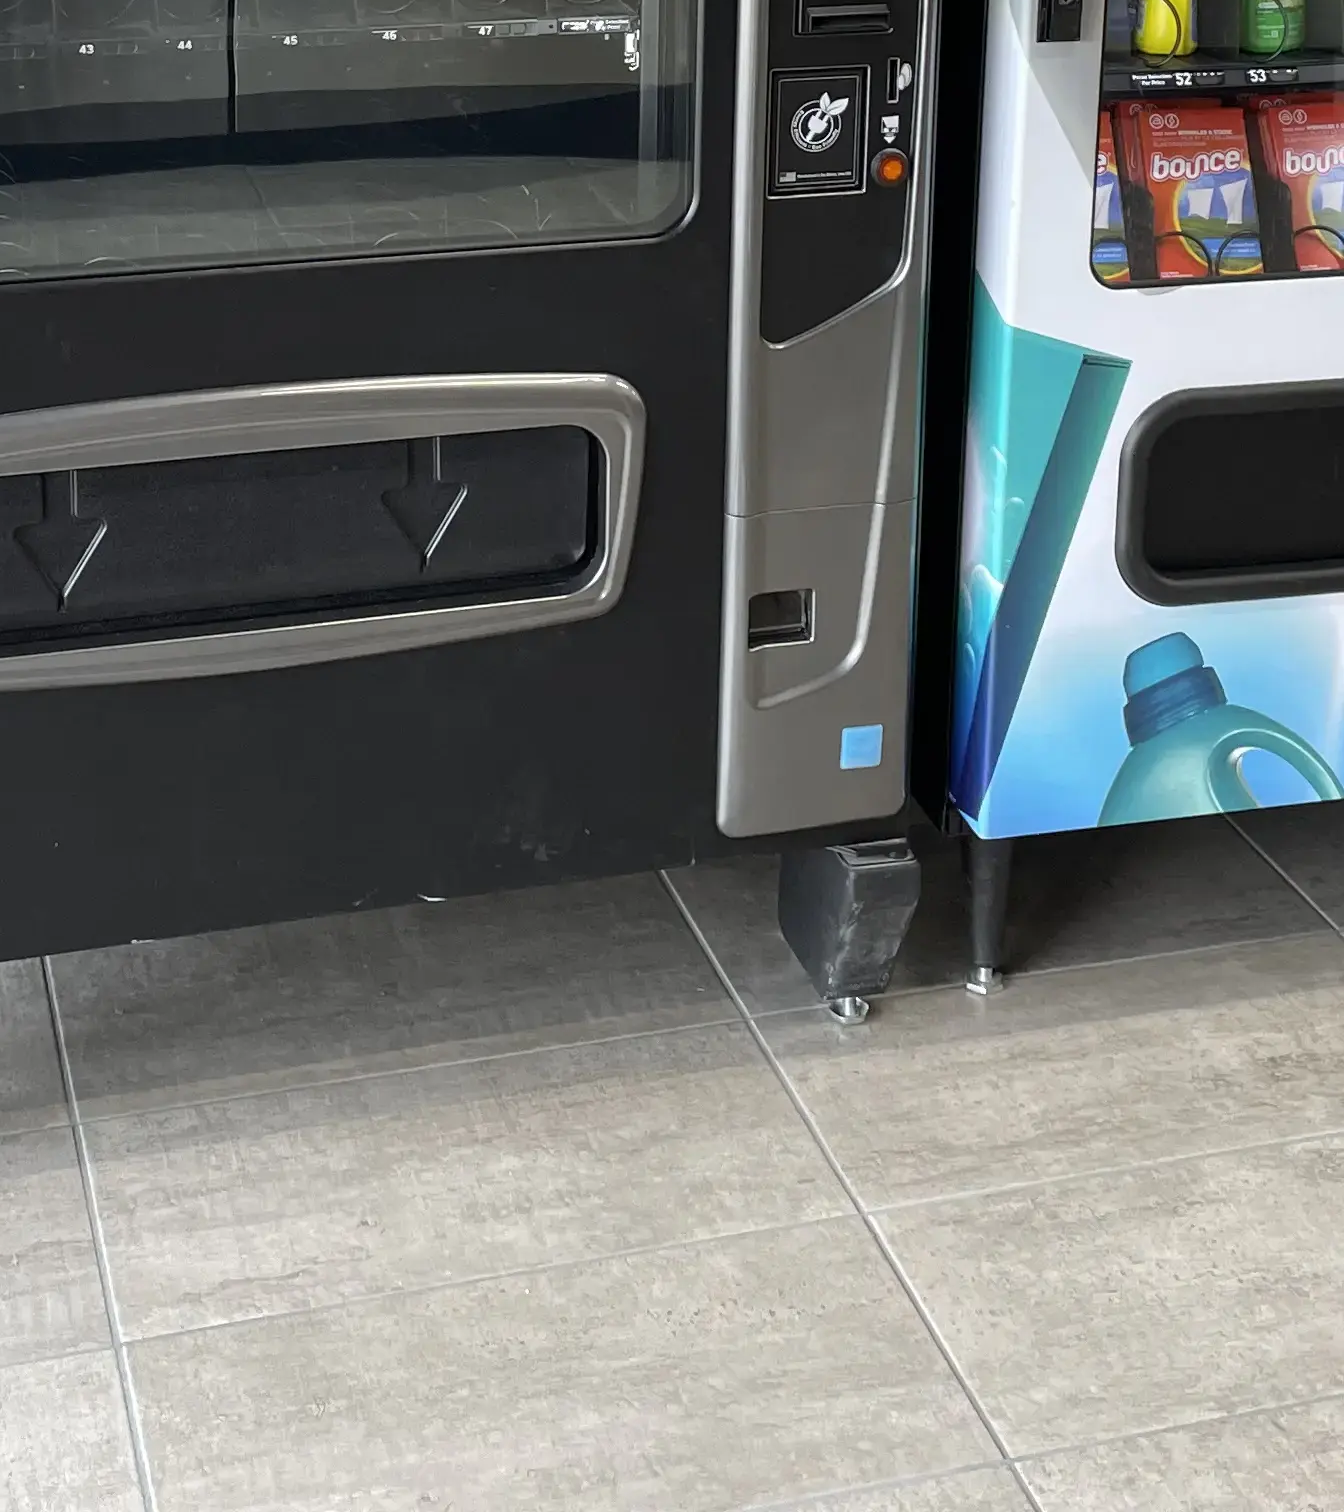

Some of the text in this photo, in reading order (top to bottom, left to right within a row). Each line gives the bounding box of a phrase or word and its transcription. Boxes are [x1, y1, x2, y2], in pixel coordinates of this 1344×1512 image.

[381, 30, 397, 41] 46
[478, 26, 493, 36] 47
[177, 40, 193, 50] 44
[283, 35, 298, 46] 45
[78, 44, 95, 55] 43
[1174, 72, 1193, 86] 52
[1248, 69, 1267, 83] 53
[1152, 148, 1242, 181] bounce
